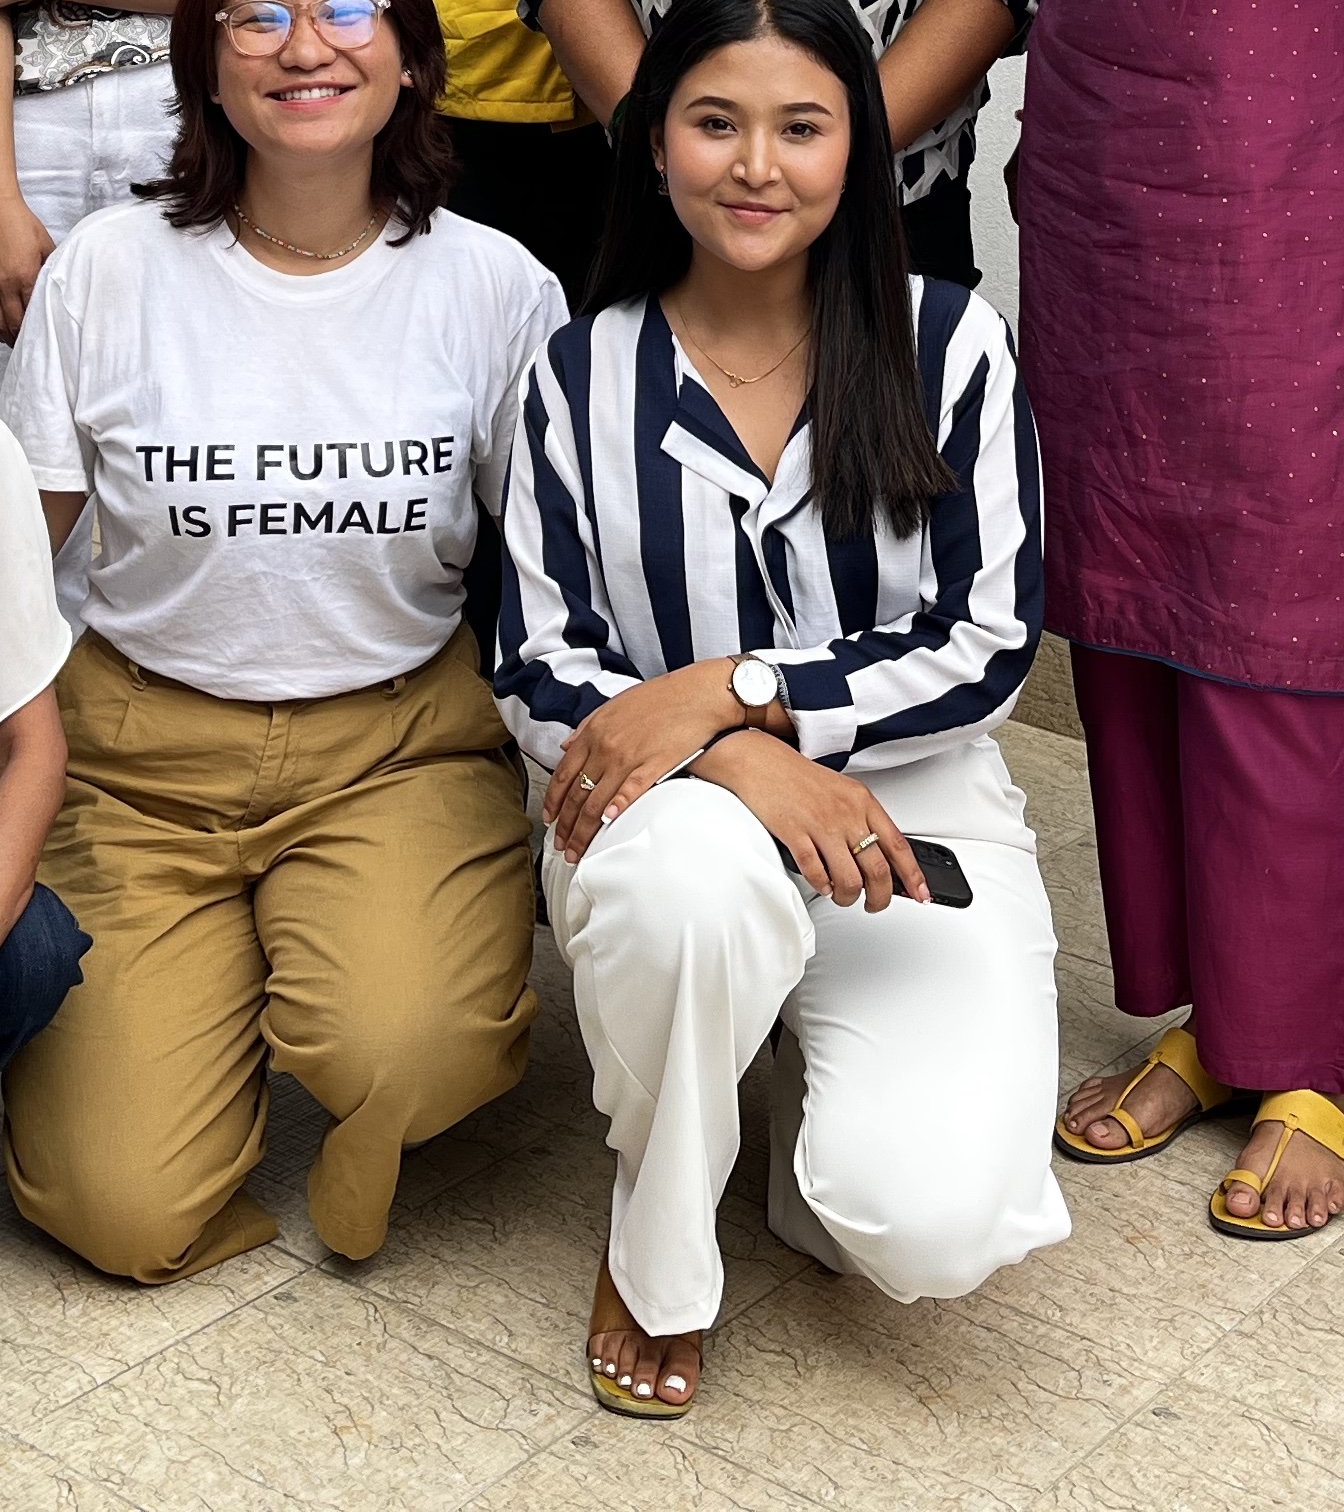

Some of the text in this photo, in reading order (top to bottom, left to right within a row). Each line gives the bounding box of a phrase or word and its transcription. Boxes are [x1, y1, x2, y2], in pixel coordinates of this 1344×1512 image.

[135, 435, 455, 482] THE FUTURE
[167, 497, 429, 538] IS FEMALE
